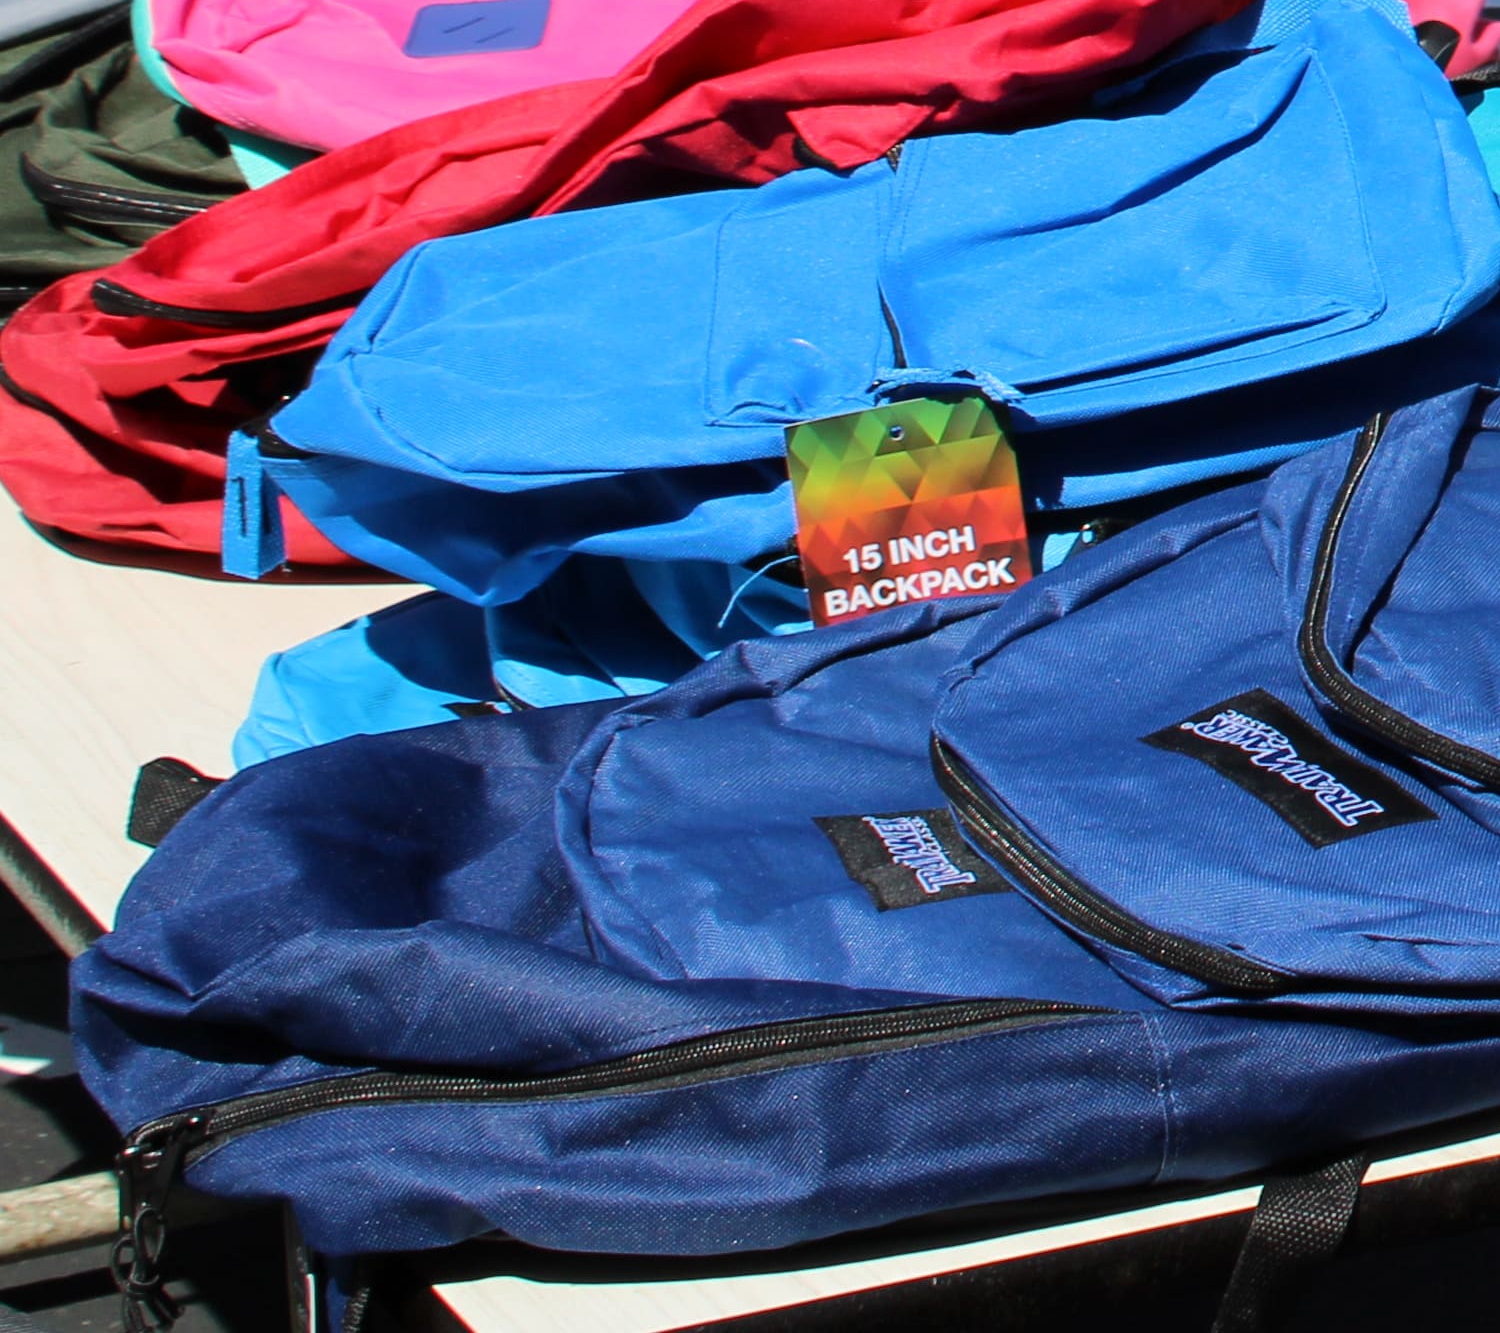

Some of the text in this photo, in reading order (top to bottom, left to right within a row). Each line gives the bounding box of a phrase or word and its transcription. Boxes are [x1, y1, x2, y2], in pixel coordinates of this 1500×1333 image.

[842, 524, 977, 575] 15 INCH
[823, 555, 1016, 618] BACKPACK
[1220, 708, 1290, 747] CLASSIC
[1192, 715, 1385, 827] TRAILMAKER
